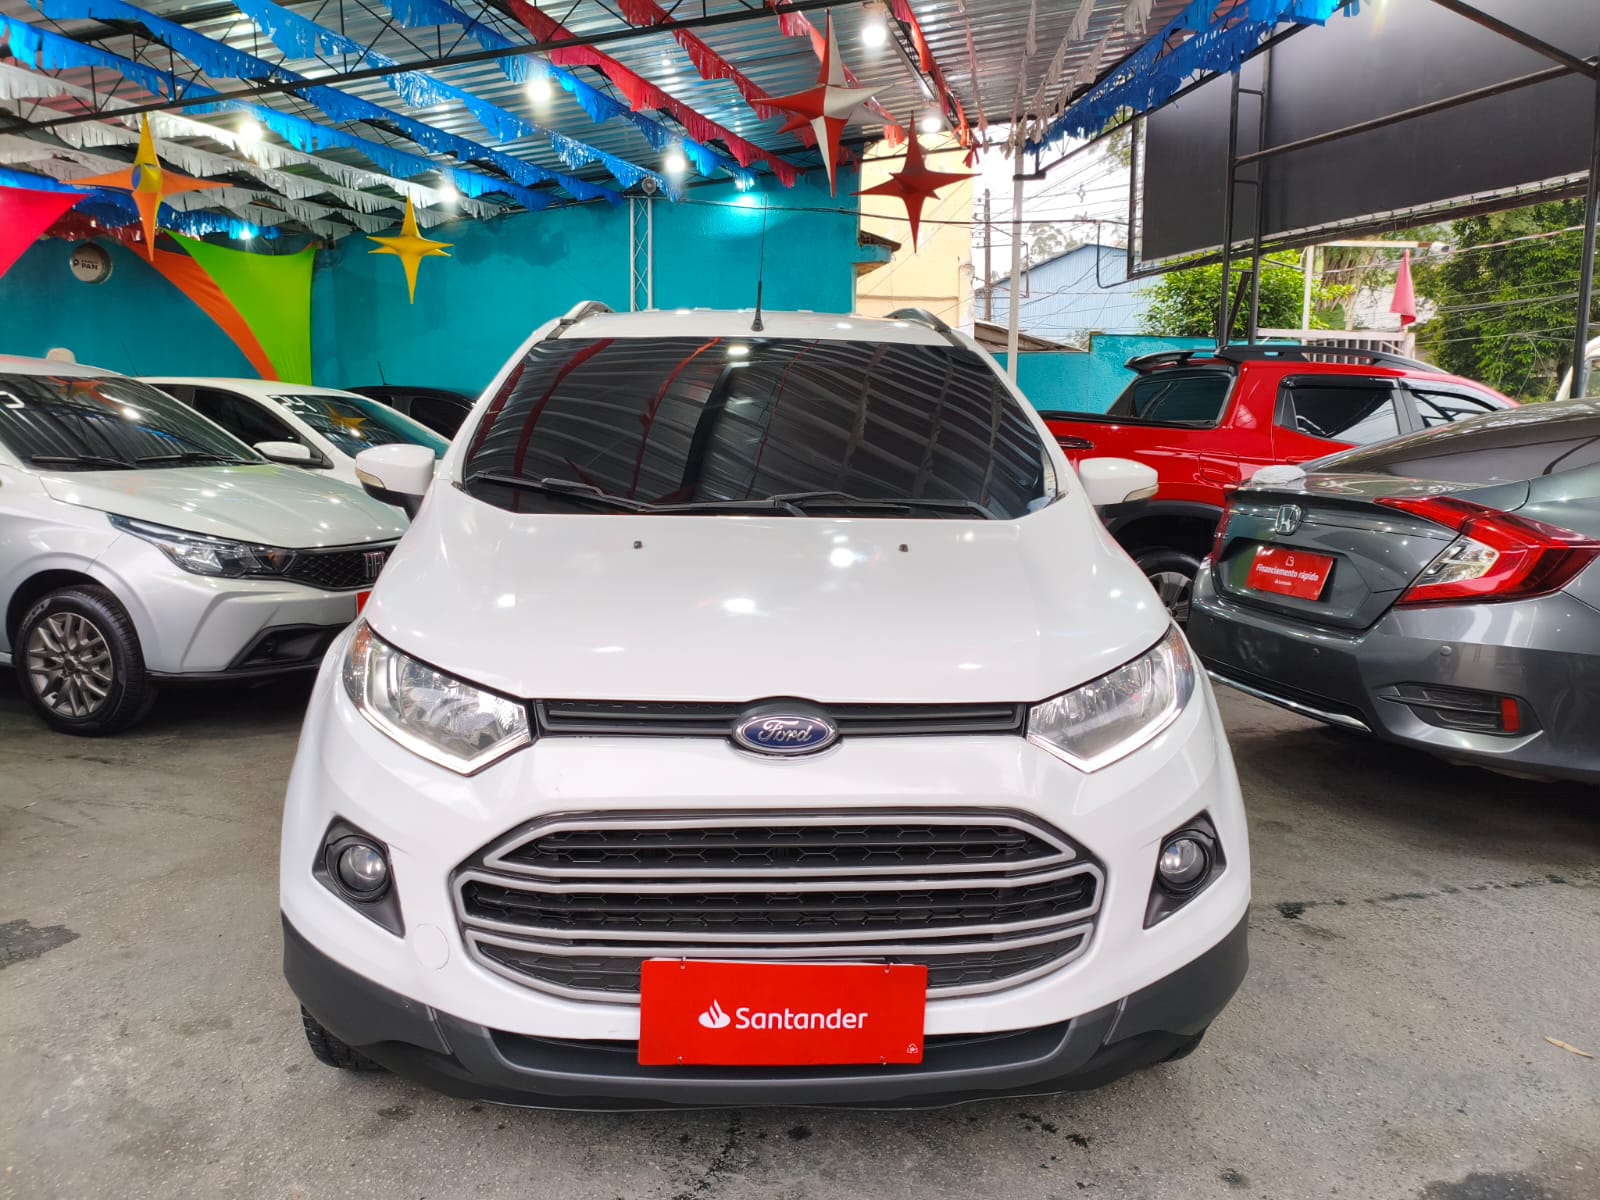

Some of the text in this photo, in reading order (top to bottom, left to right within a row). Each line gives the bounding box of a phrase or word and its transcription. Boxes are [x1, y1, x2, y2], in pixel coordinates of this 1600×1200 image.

[81, 262, 98, 271] PAN
[1256, 563, 1320, 582] Financiamento rápido
[757, 719, 813, 743] Ford
[735, 1006, 868, 1031] Santander
